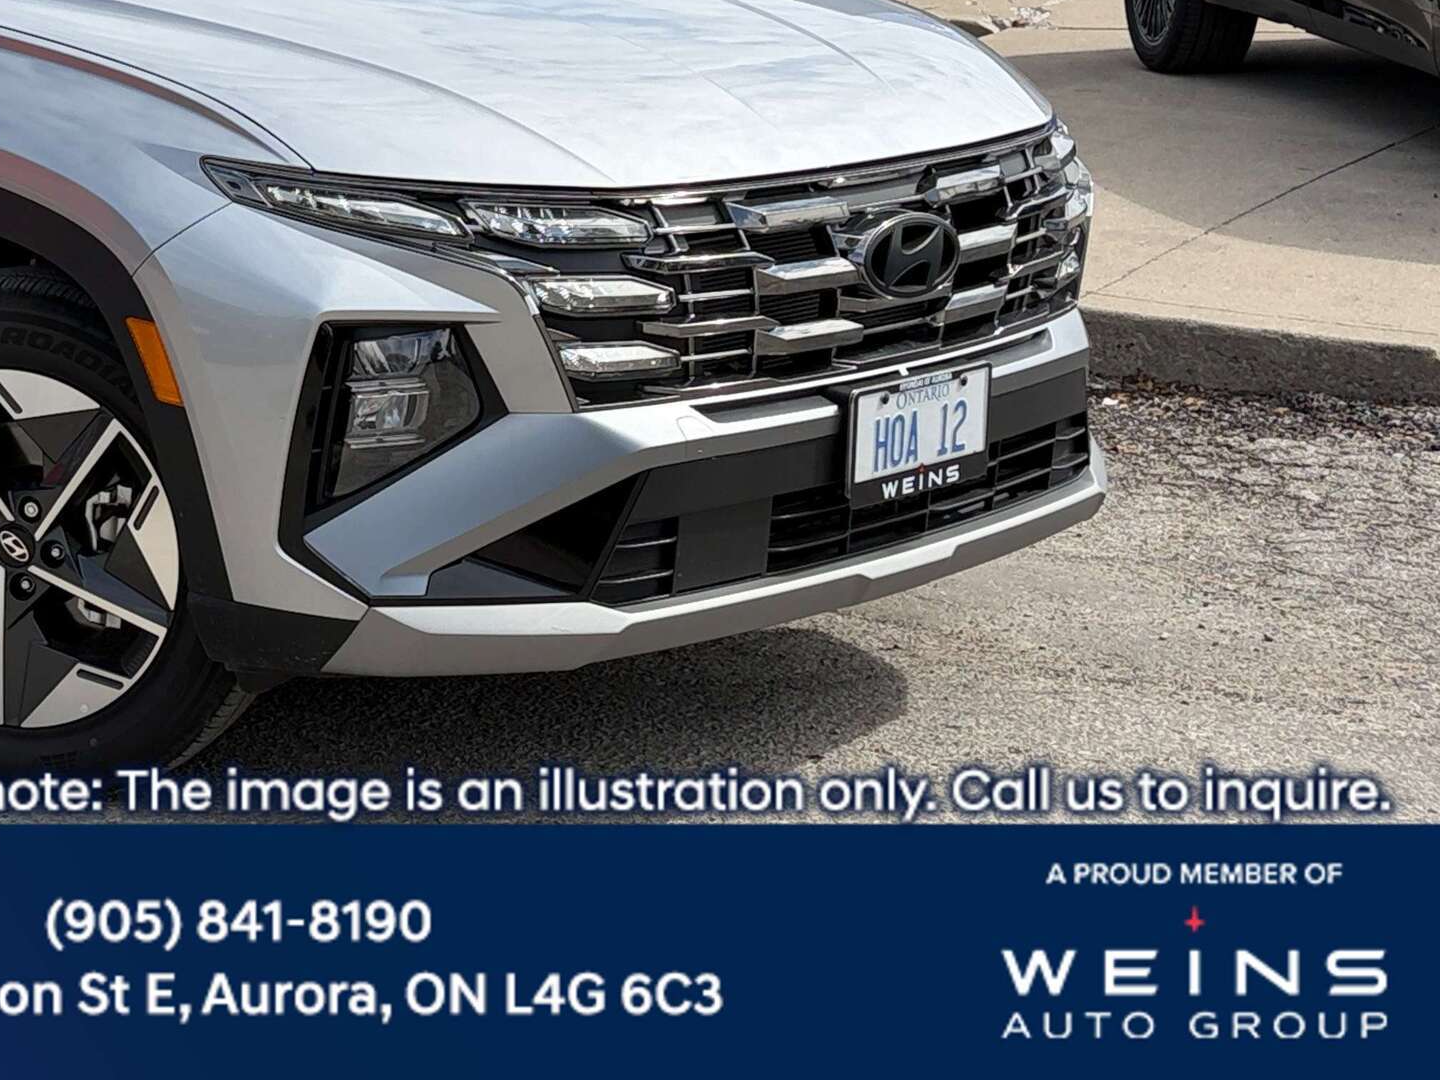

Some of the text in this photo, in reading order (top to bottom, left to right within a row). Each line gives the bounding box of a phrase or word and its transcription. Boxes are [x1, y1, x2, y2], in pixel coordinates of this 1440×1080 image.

[896, 383, 951, 410] ONTARIO
[873, 399, 968, 473] HOA 12
[881, 464, 961, 500] WEINS
